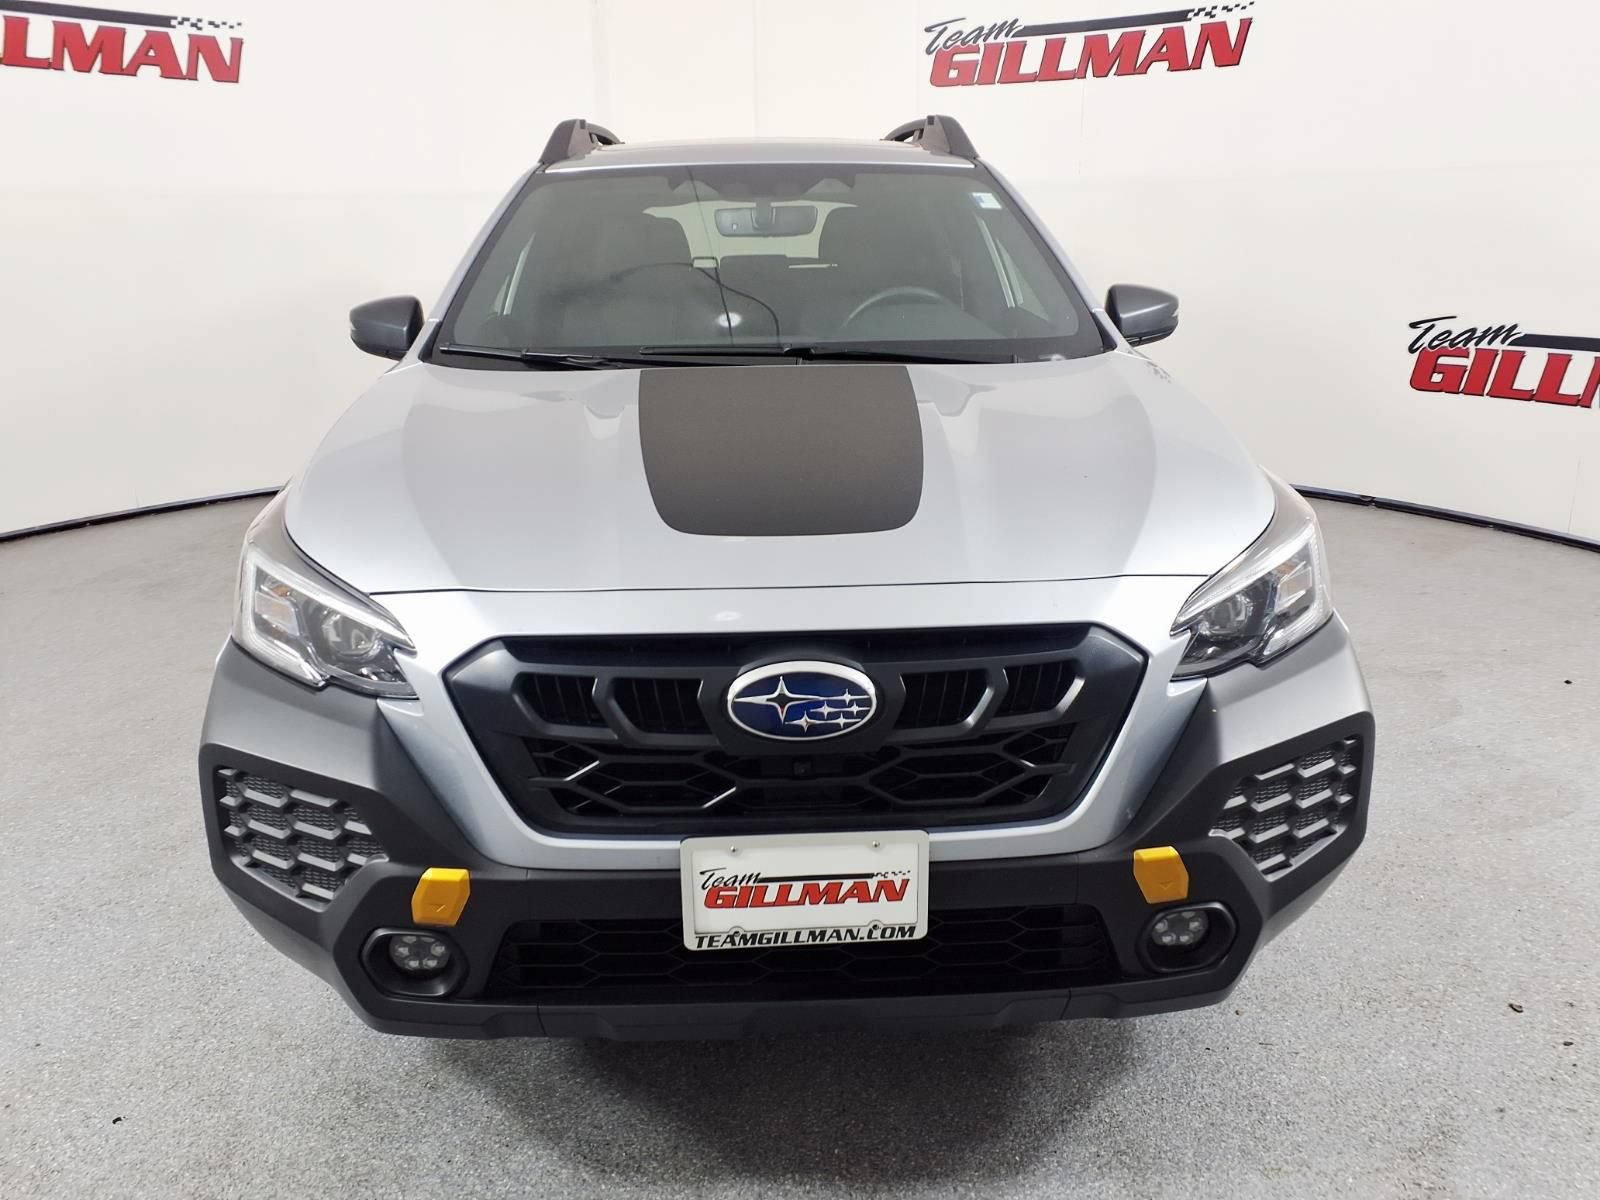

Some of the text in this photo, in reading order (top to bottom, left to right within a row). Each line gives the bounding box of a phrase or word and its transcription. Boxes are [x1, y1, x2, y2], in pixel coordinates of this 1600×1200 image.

[0, 15, 243, 83] LMAN
[924, 17, 1022, 56] Team
[929, 17, 1253, 87] GILLMAN
[1408, 315, 1521, 354] Team
[1409, 347, 1600, 408] GILL
[699, 867, 761, 890] Team
[704, 879, 910, 909] GILLMAN
[695, 925, 916, 949] TEAMGILLMAN.COM
